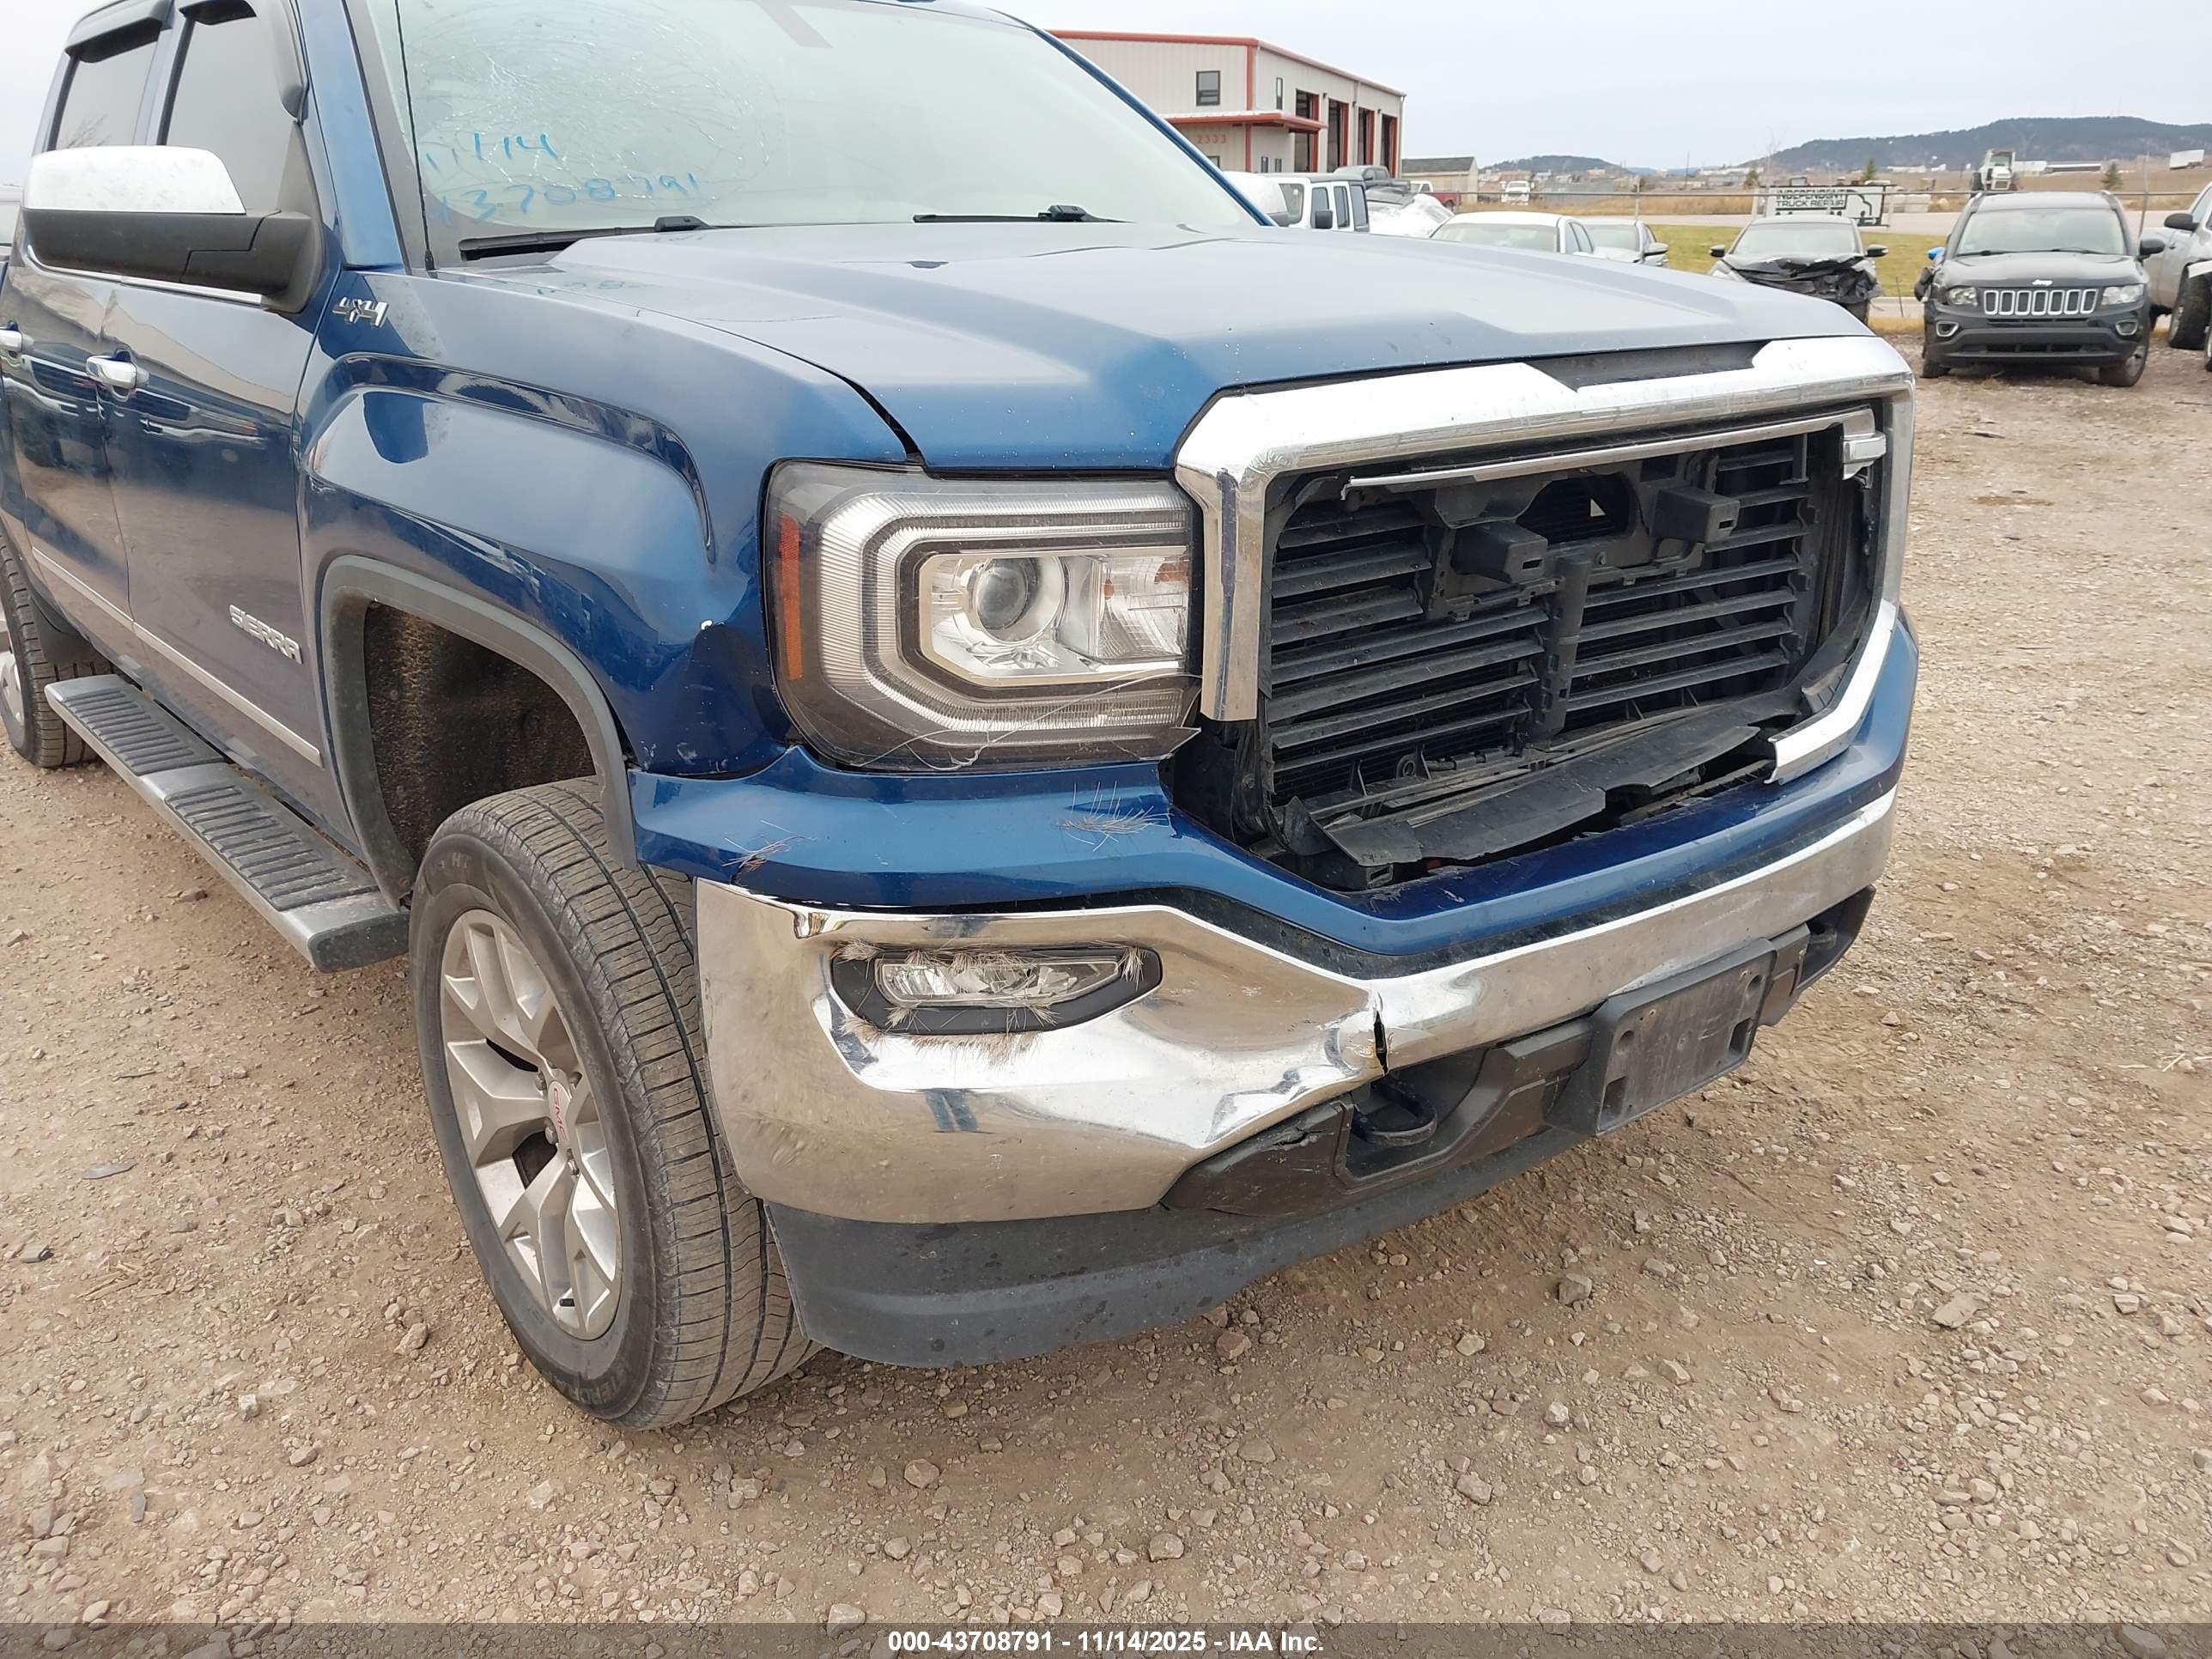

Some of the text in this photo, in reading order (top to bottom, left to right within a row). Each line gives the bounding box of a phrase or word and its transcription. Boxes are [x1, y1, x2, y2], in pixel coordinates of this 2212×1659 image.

[1776, 189, 1844, 199] INDEPENDENT
[228, 604, 304, 665] SIERRA
[553, 1087, 569, 1141] GMC
